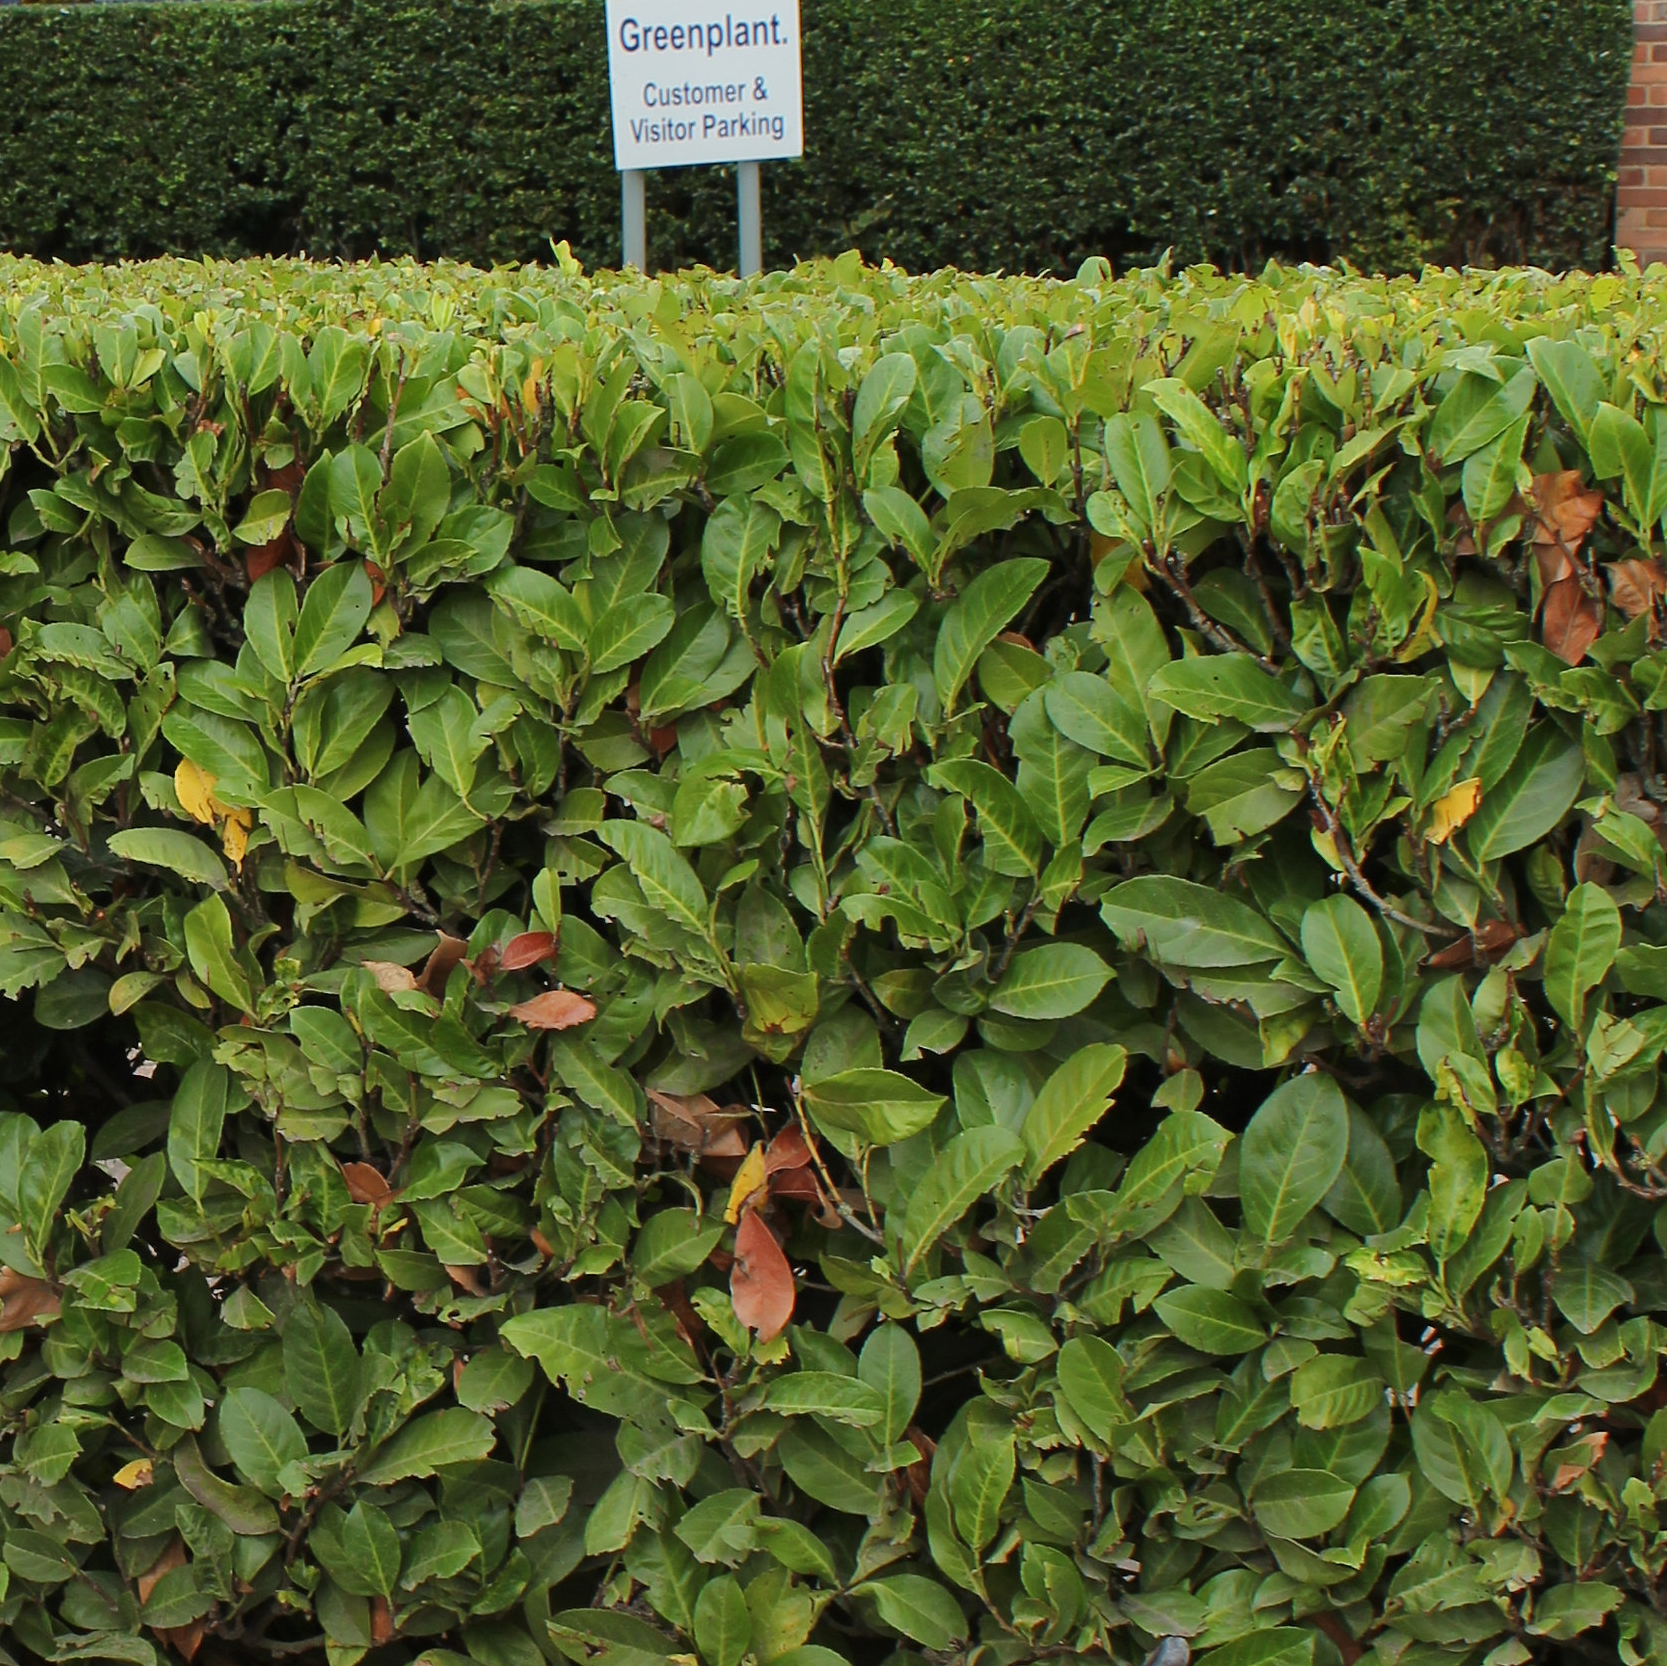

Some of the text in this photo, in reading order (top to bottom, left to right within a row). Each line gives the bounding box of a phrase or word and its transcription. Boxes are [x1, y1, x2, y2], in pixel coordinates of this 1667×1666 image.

[619, 13, 788, 57] Greenplant.
[643, 76, 768, 108] Customer &
[630, 111, 784, 144] Visitor Parking
